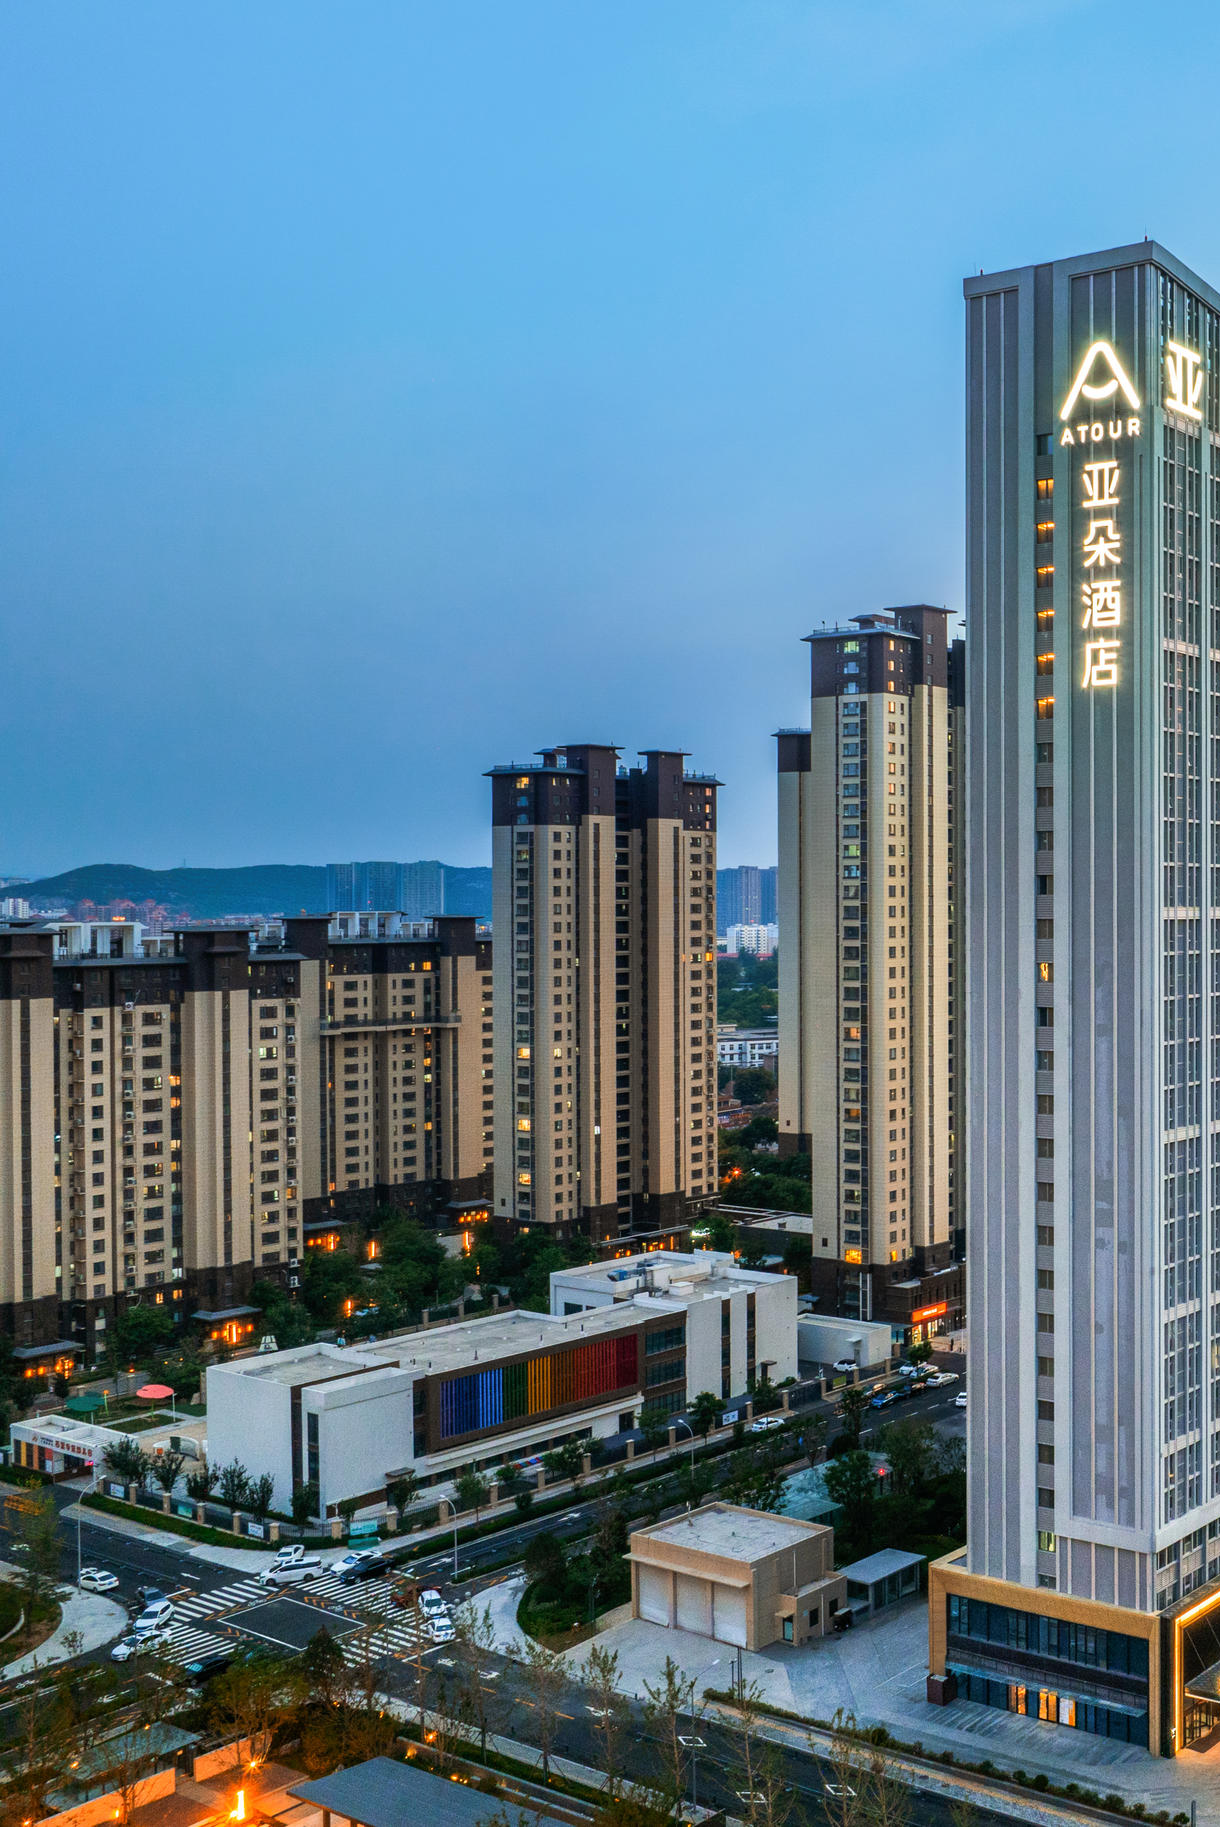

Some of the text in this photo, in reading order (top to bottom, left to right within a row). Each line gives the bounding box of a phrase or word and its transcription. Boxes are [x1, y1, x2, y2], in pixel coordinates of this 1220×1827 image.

[1060, 416, 1141, 446] ATOUR
[1082, 461, 1121, 688] 亚朵酒店
